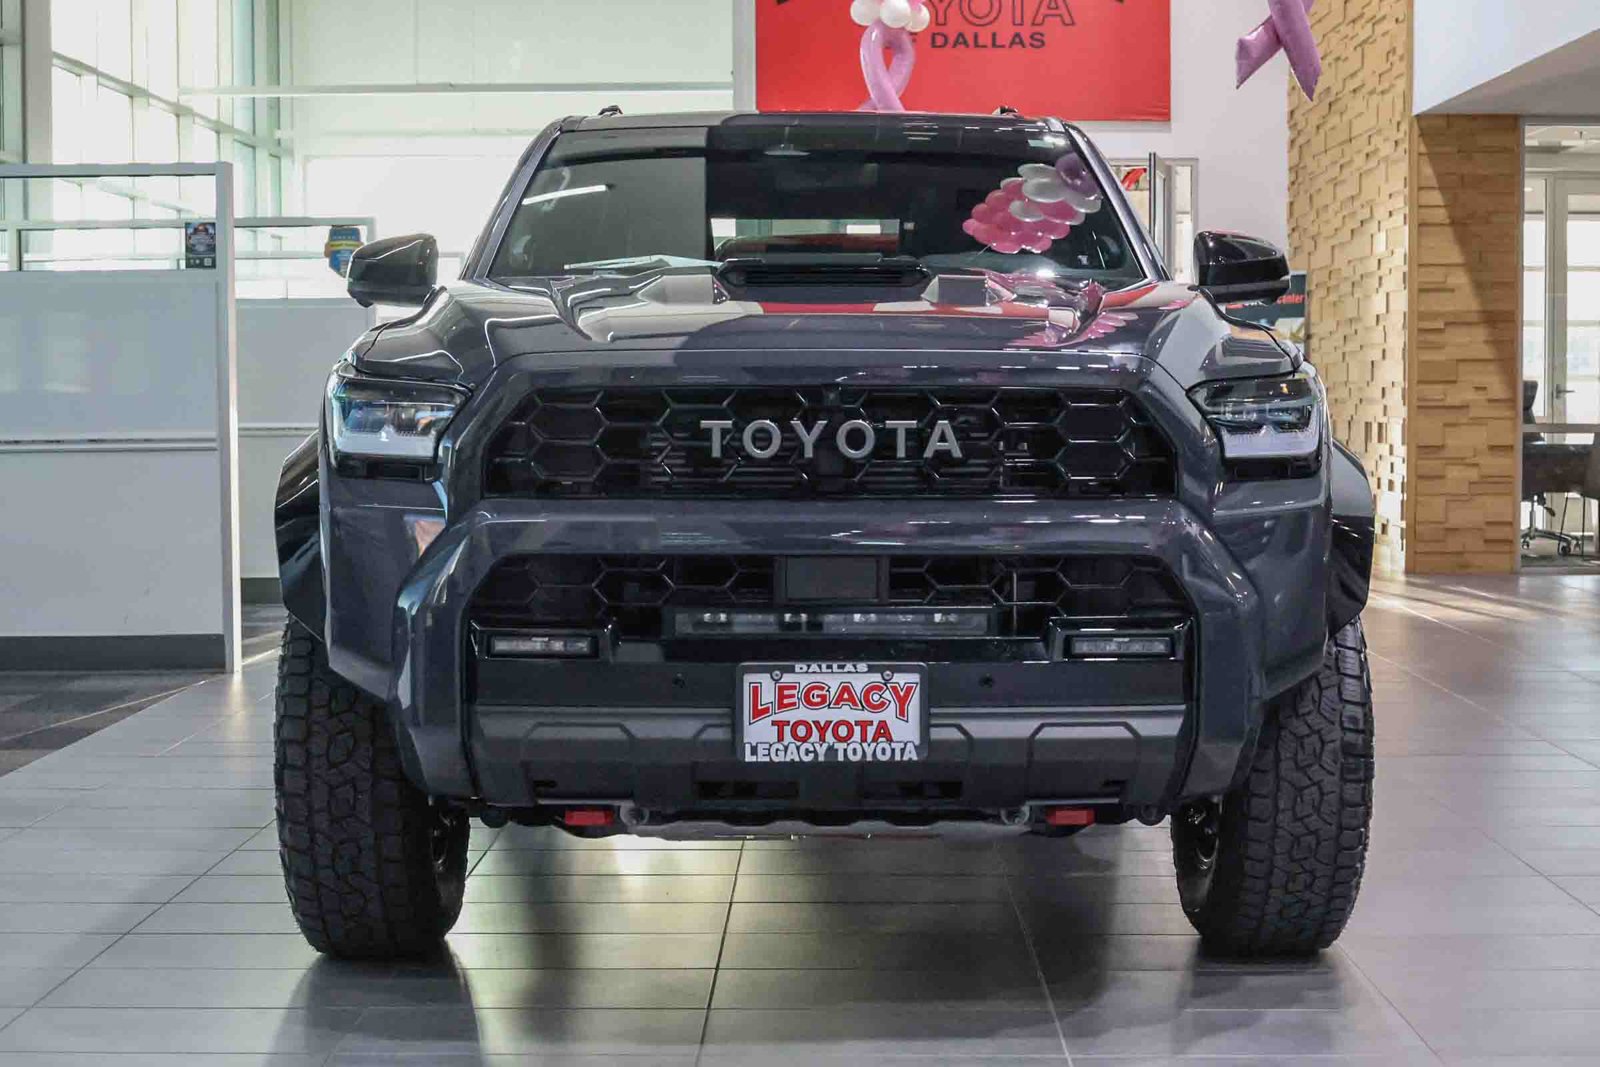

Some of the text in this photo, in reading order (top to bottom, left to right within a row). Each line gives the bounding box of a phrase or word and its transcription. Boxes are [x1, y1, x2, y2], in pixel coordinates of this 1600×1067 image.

[928, 0, 1076, 27] YOTA
[930, 32, 1046, 49] DALLAS
[700, 419, 963, 459] TOYOTA
[794, 664, 869, 673] DALLAS
[749, 681, 918, 726] LEGACY
[771, 719, 894, 743] TOYOTA
[744, 742, 918, 763] LEGACY TOYOTA
